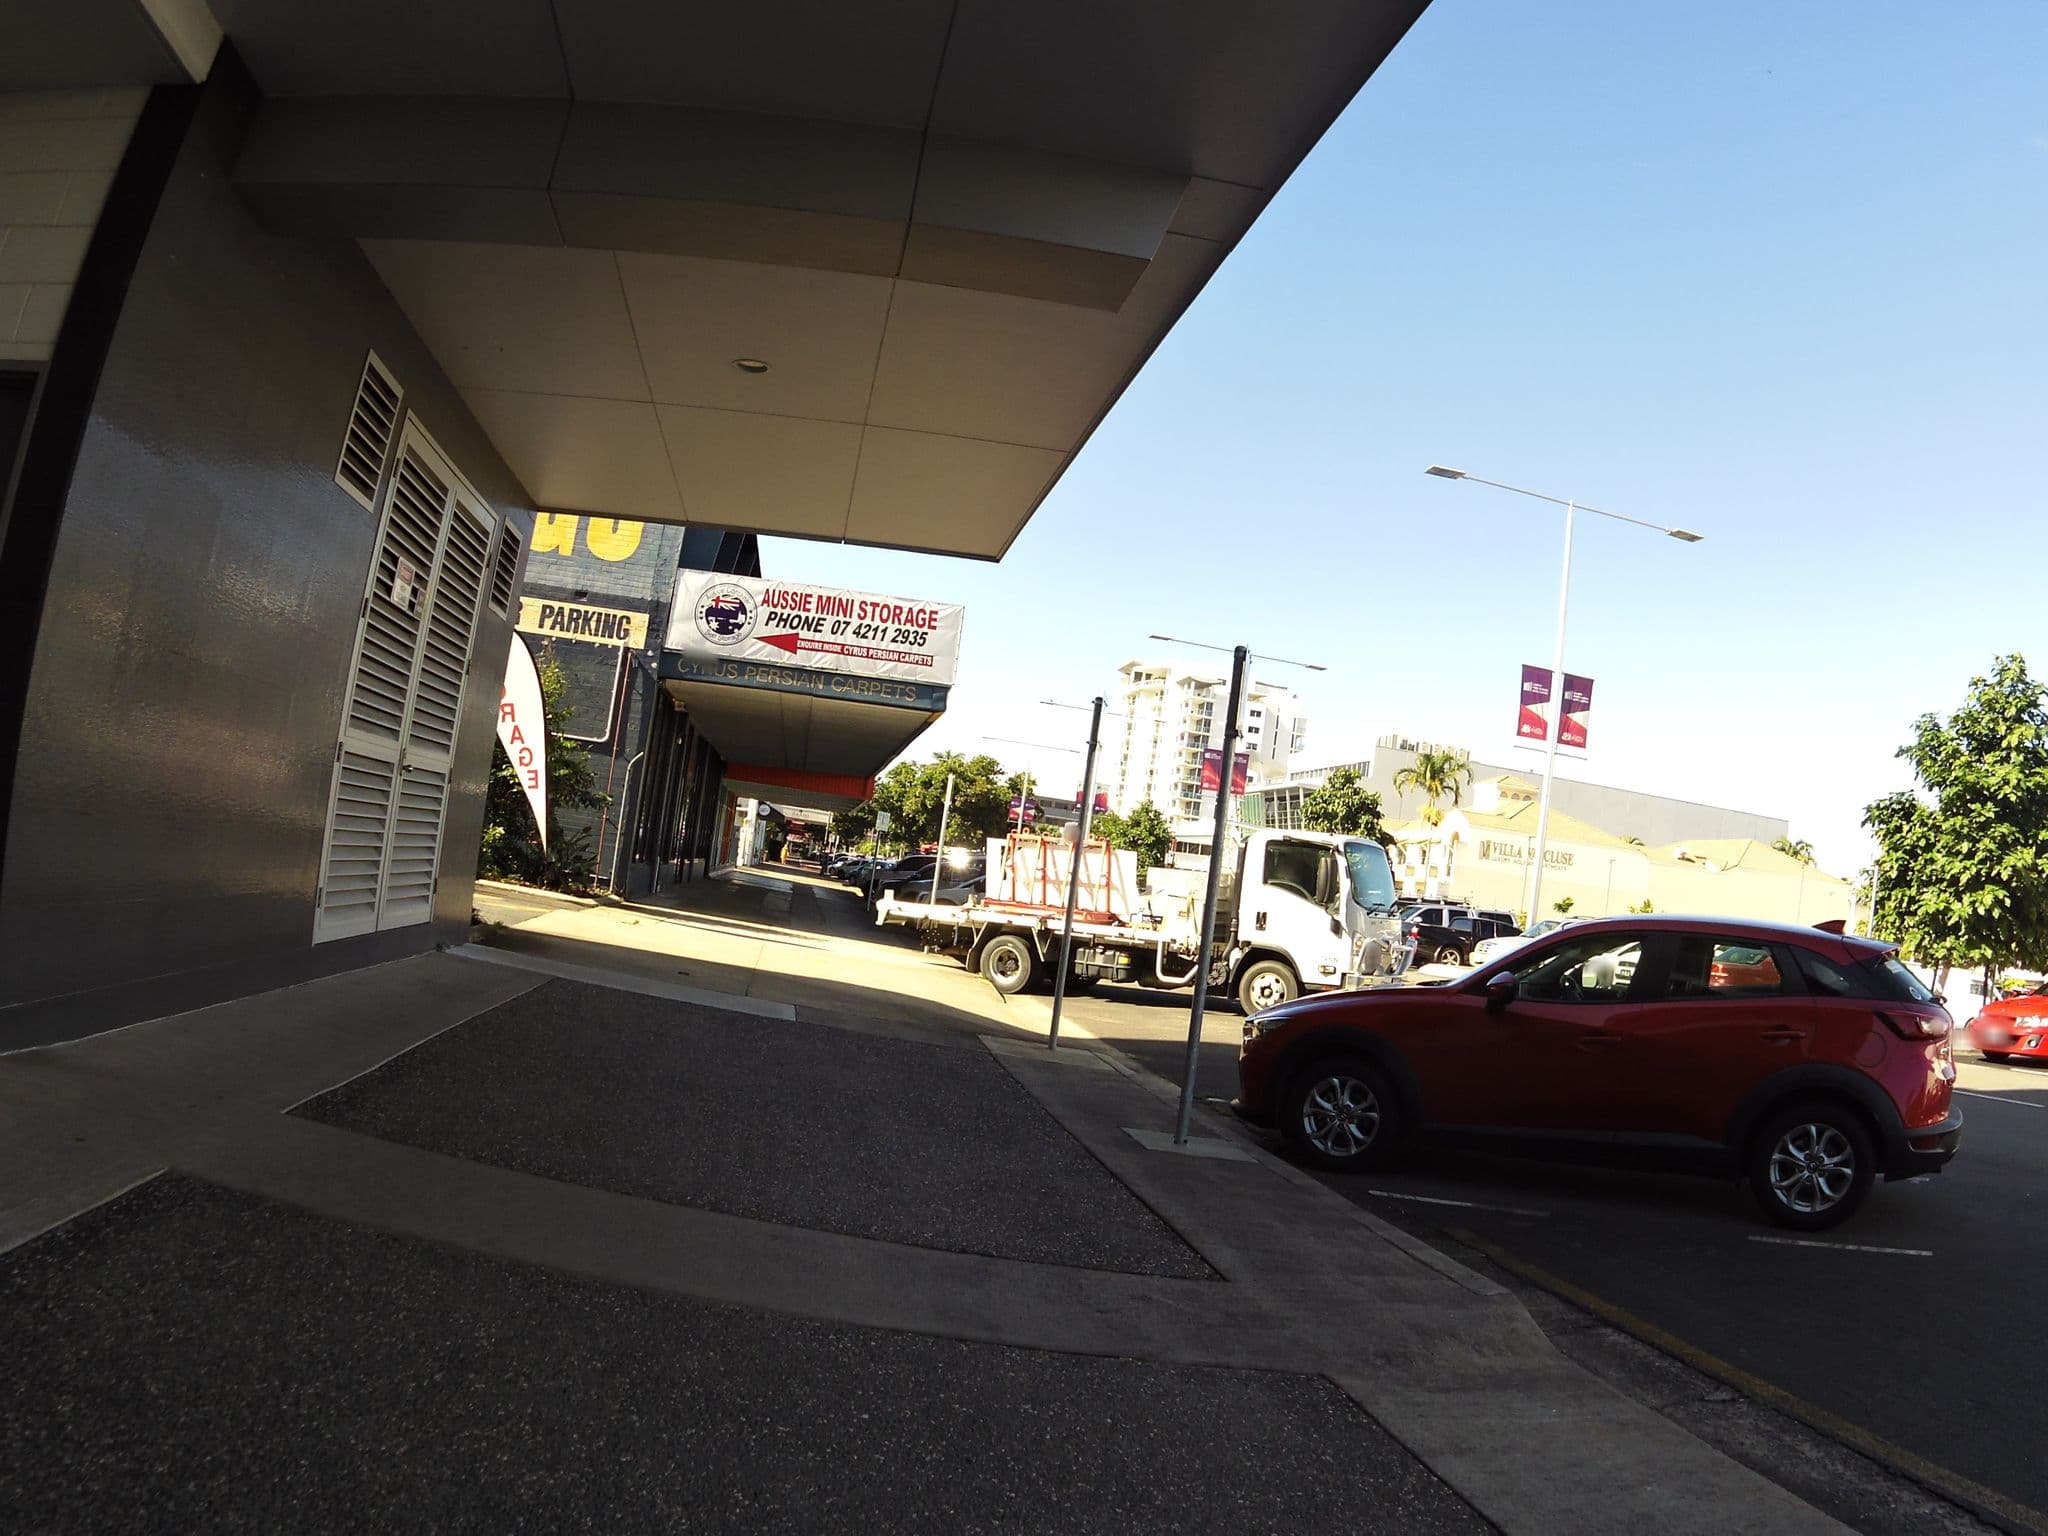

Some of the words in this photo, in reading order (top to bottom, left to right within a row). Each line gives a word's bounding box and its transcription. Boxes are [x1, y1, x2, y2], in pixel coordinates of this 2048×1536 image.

[538, 603, 632, 640] PARKING
[761, 588, 813, 613] AUSSIE
[815, 594, 855, 619] MINI
[857, 600, 938, 630] STORAGE
[764, 611, 827, 633] PHONE
[830, 619, 851, 636] 07
[852, 623, 888, 642] 4211
[890, 628, 928, 647] 2935
[844, 645, 867, 657] CYRUS
[869, 648, 899, 661] PERSIAN
[900, 652, 932, 665] CARPETS
[744, 666, 824, 690] PERSIAN
[831, 677, 917, 702] CARPETS
[1493, 841, 1522, 859] VILLA
